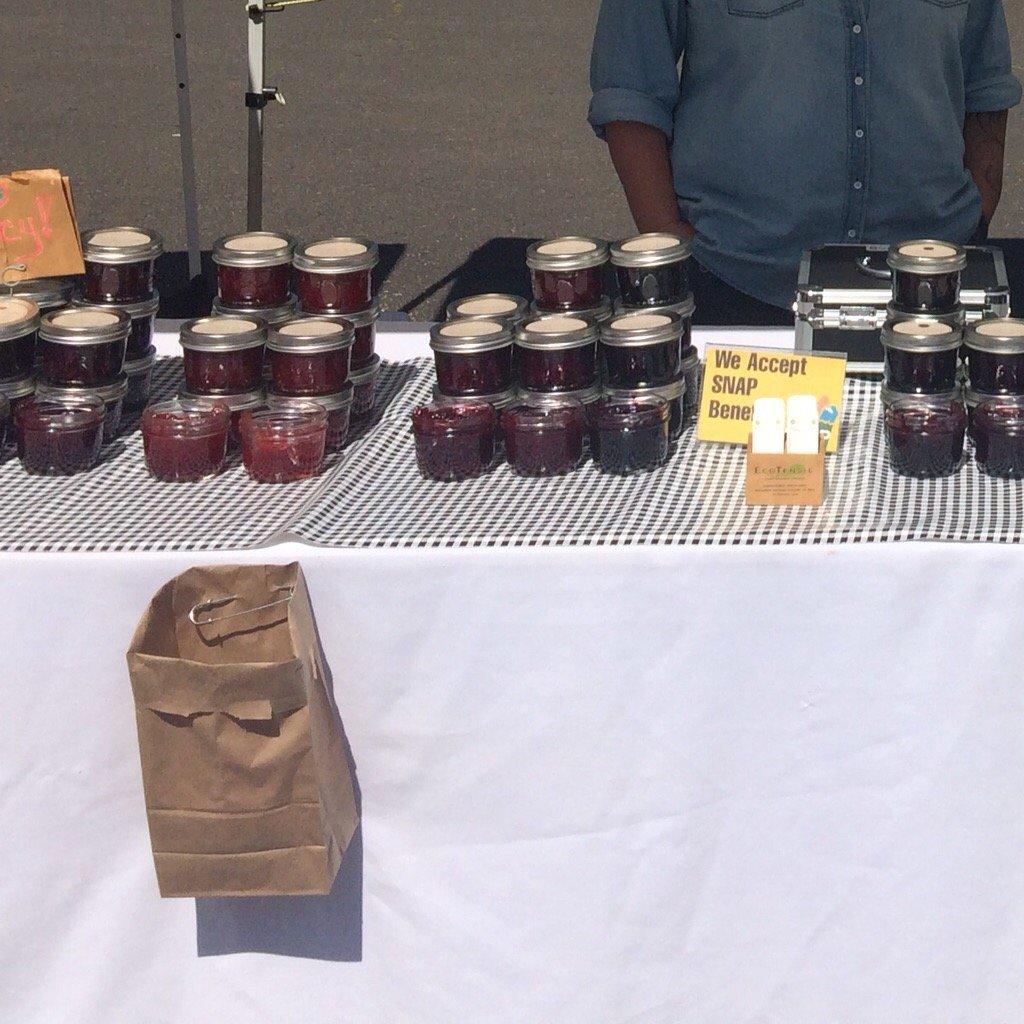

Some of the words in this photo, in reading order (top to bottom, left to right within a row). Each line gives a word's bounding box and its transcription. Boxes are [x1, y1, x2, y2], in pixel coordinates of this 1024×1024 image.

[715, 350, 741, 369] We
[747, 352, 807, 377] Accept
[711, 375, 758, 396] SNAP
[709, 400, 754, 421] Bene
